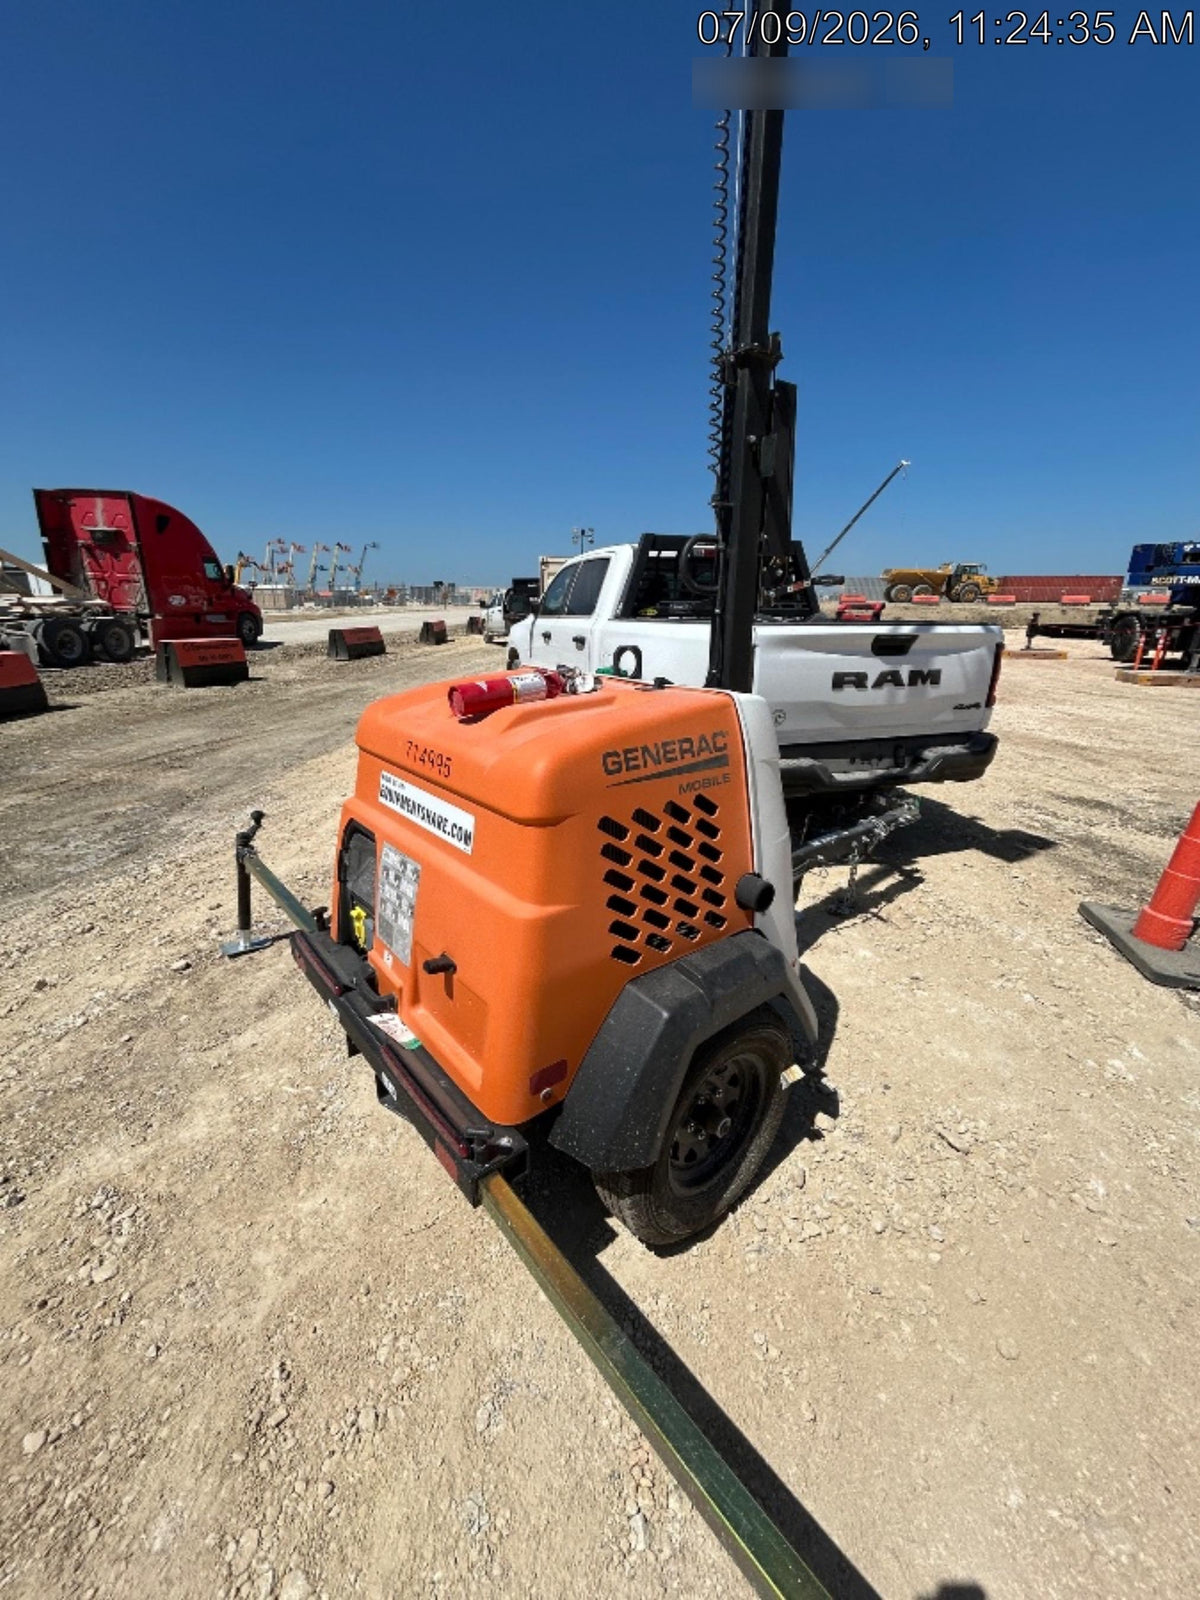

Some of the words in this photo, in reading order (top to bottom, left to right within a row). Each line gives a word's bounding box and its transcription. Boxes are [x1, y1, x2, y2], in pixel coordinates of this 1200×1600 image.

[832, 669, 941, 691] RAM
[405, 740, 453, 778] 714995
[602, 731, 729, 776] GENERAC
[678, 772, 732, 795] MOBILE
